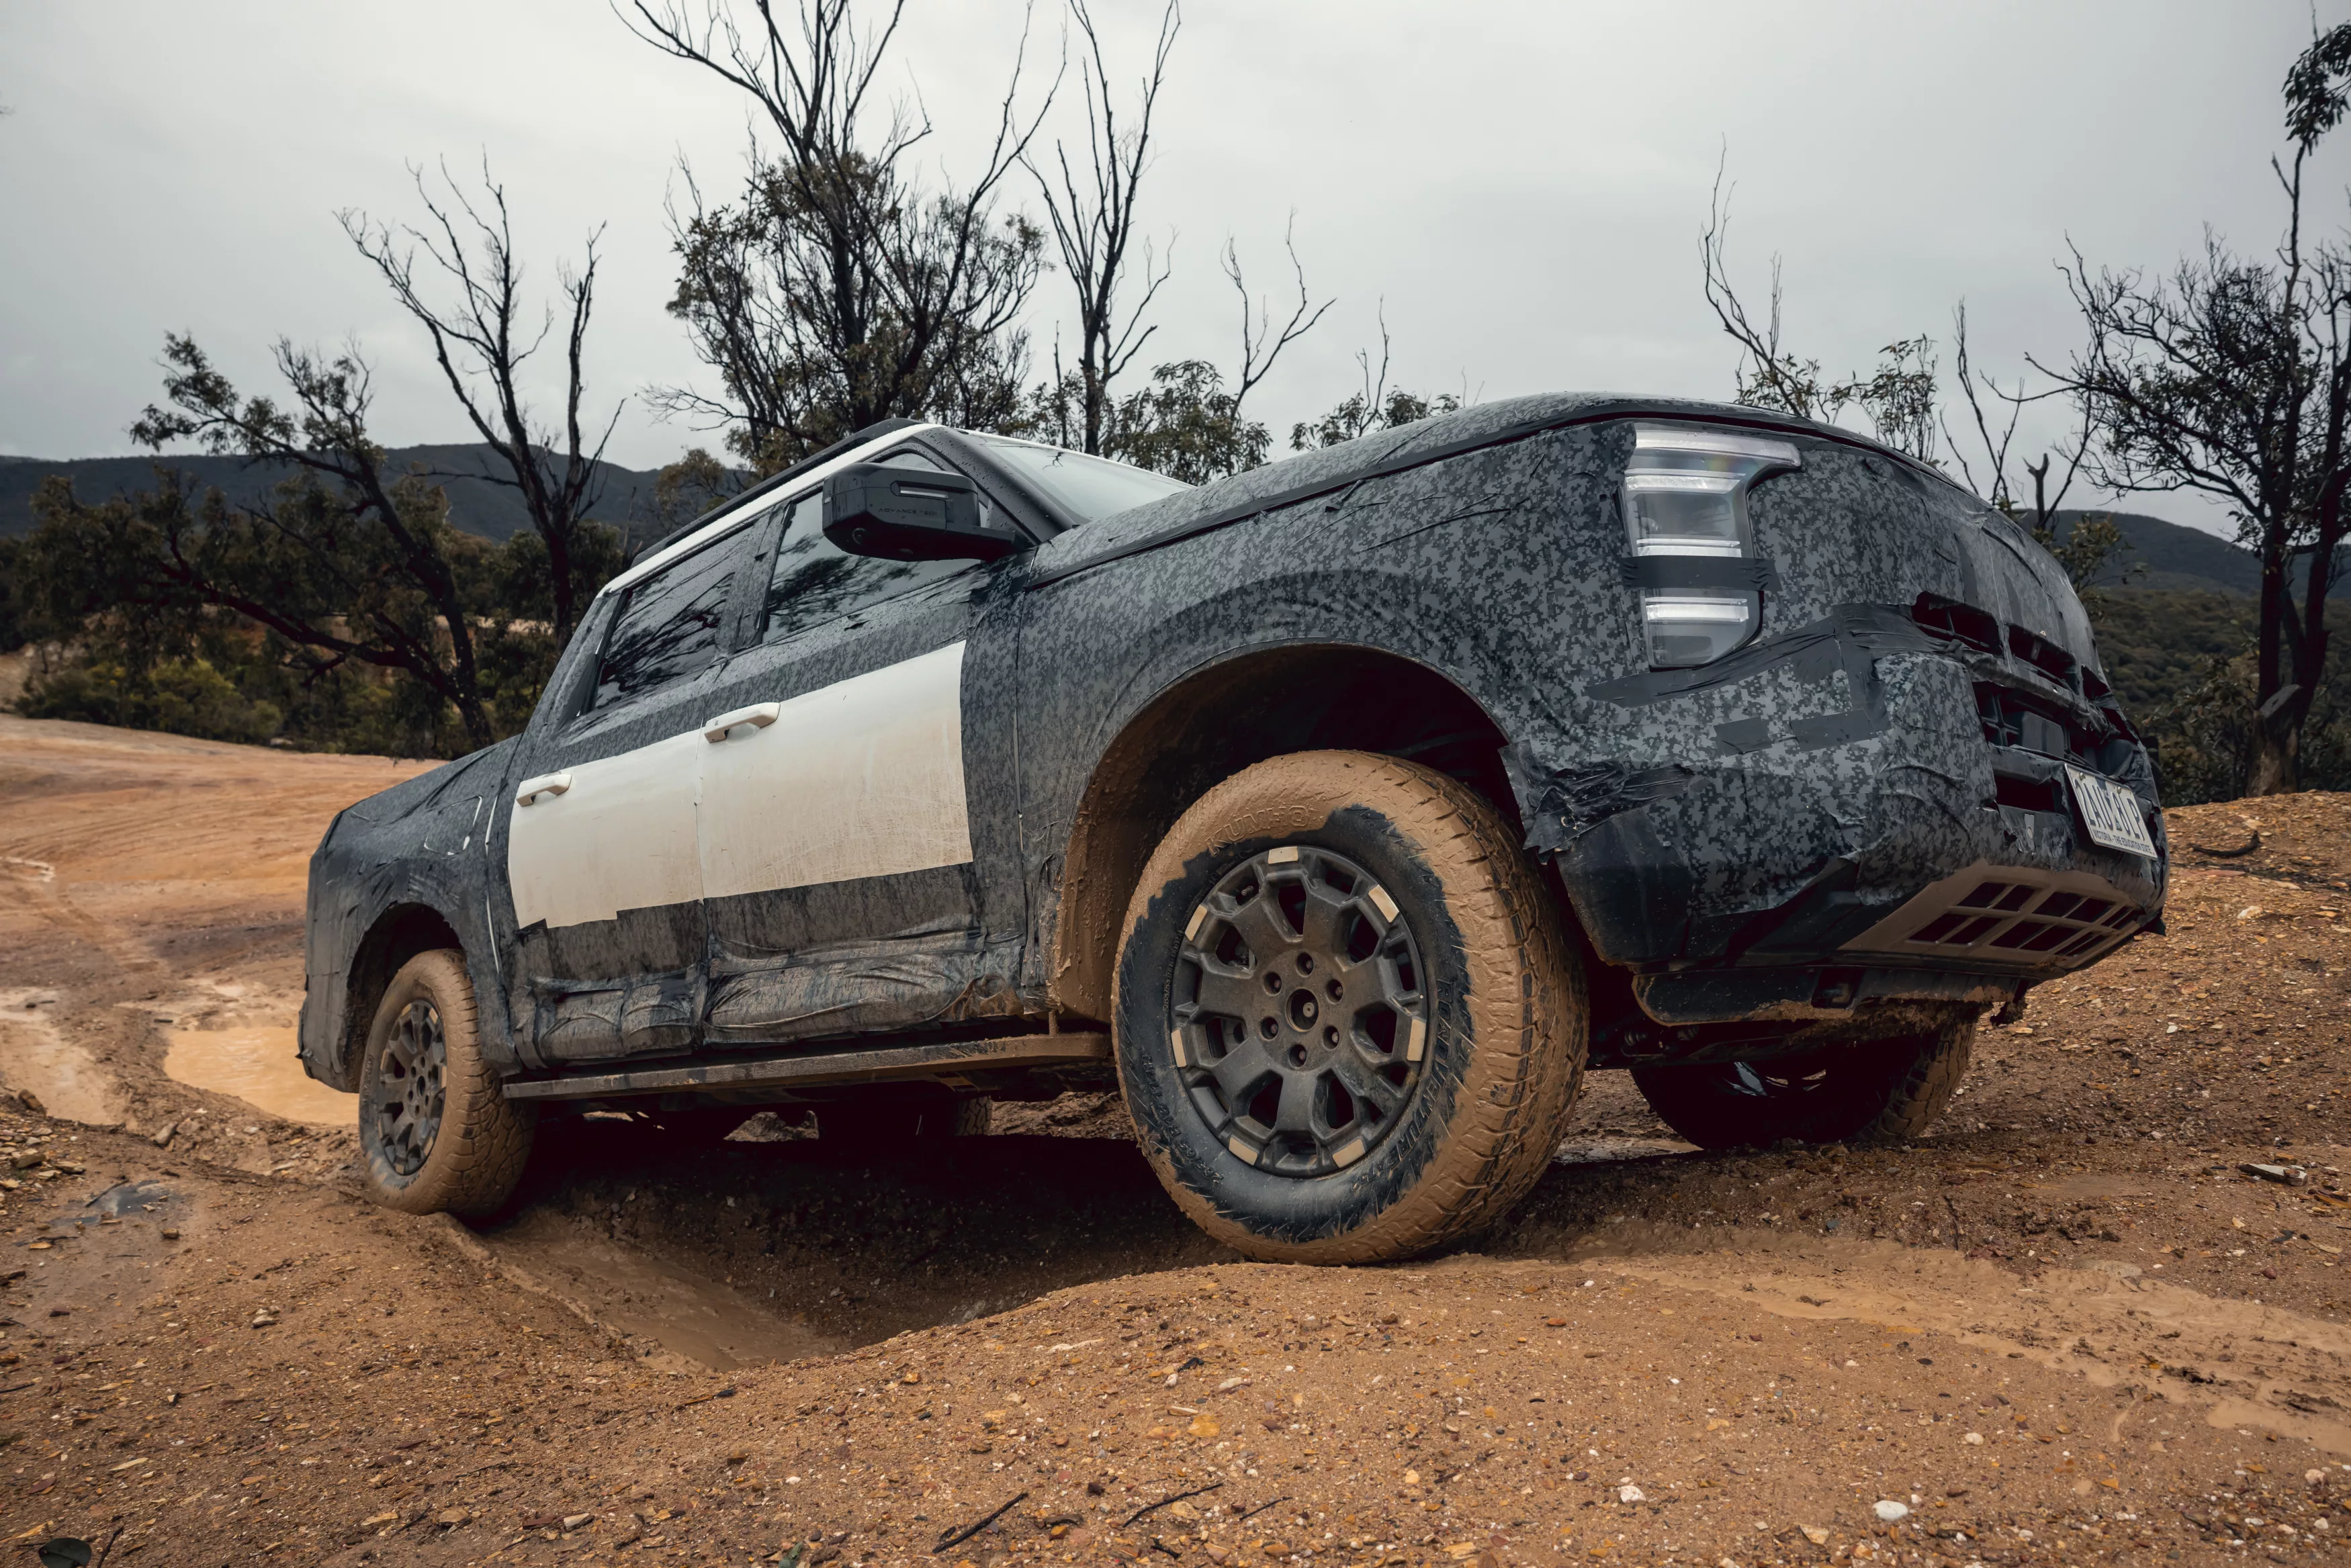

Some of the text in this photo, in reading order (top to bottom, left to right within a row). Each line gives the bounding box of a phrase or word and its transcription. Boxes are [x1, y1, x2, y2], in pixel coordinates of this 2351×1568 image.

[1206, 806, 1309, 857] KUMHO
[2092, 829, 2113, 842] VICTORIA
[2113, 835, 2123, 846] THE
[2121, 837, 2141, 850] EDUCATION
[2140, 843, 2152, 854] STATE
